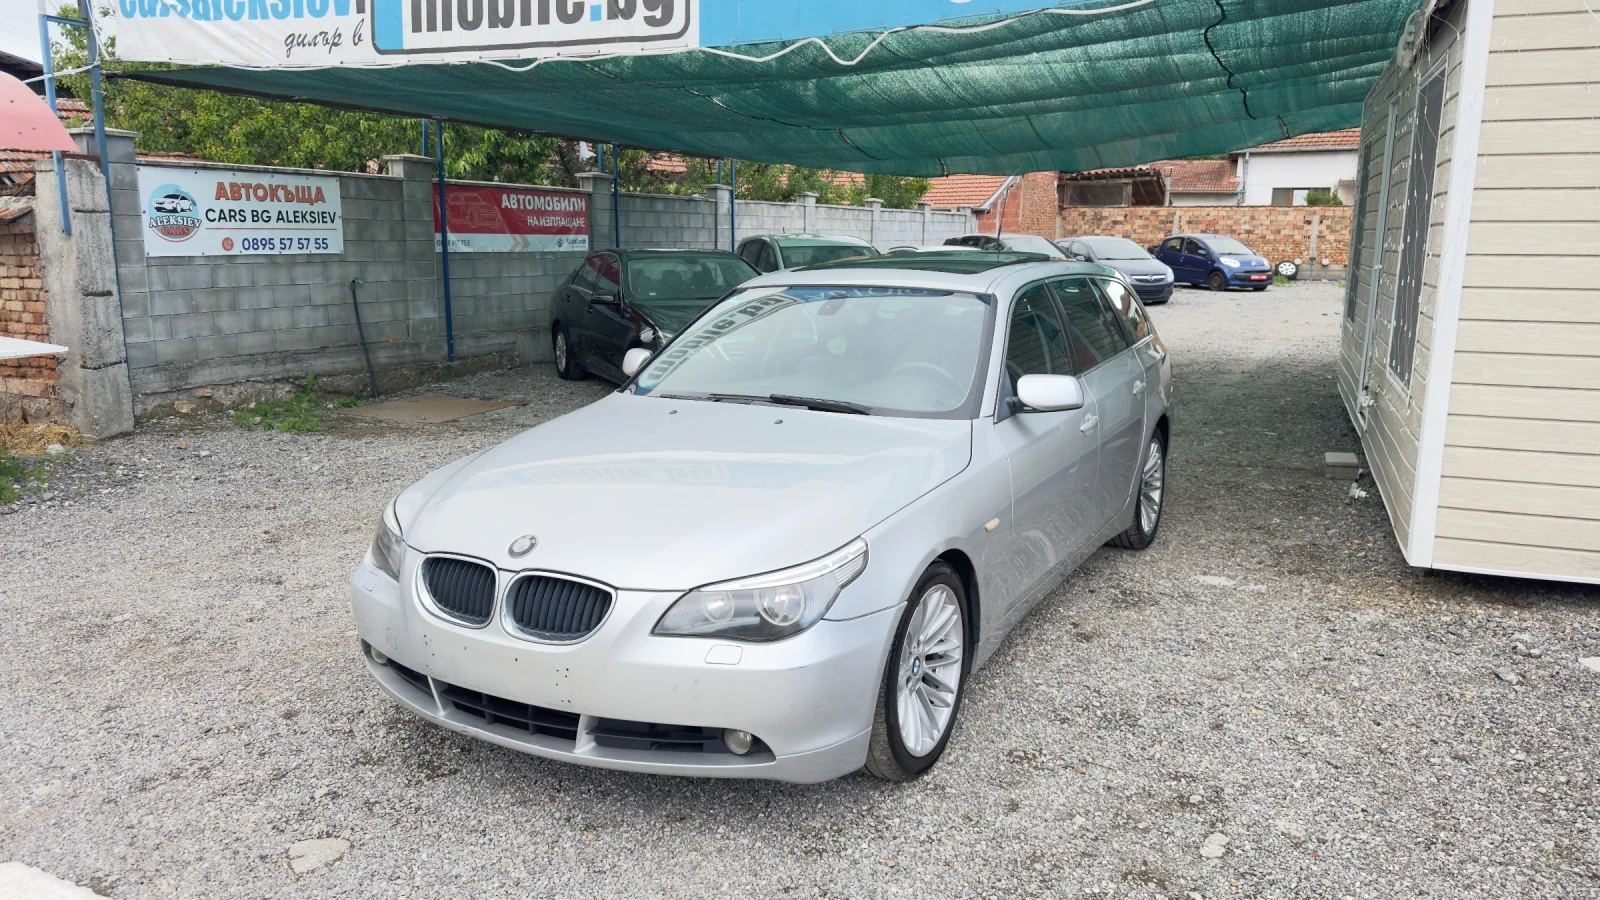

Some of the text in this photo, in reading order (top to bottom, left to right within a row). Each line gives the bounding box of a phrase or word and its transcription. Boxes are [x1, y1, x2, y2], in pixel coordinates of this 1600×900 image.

[284, 18, 364, 58] дилър в
[215, 181, 327, 206] АВТОКЪЩА
[501, 193, 586, 212] АВТОМОБИЛИ
[149, 215, 202, 229] ALEKSIEV
[205, 208, 337, 225] CARS BG ALEKSIEV
[527, 216, 586, 229] НА ИЗПЛАЩАНЕ
[161, 226, 190, 236] CARS
[242, 238, 328, 251] 0895 57 57 55
